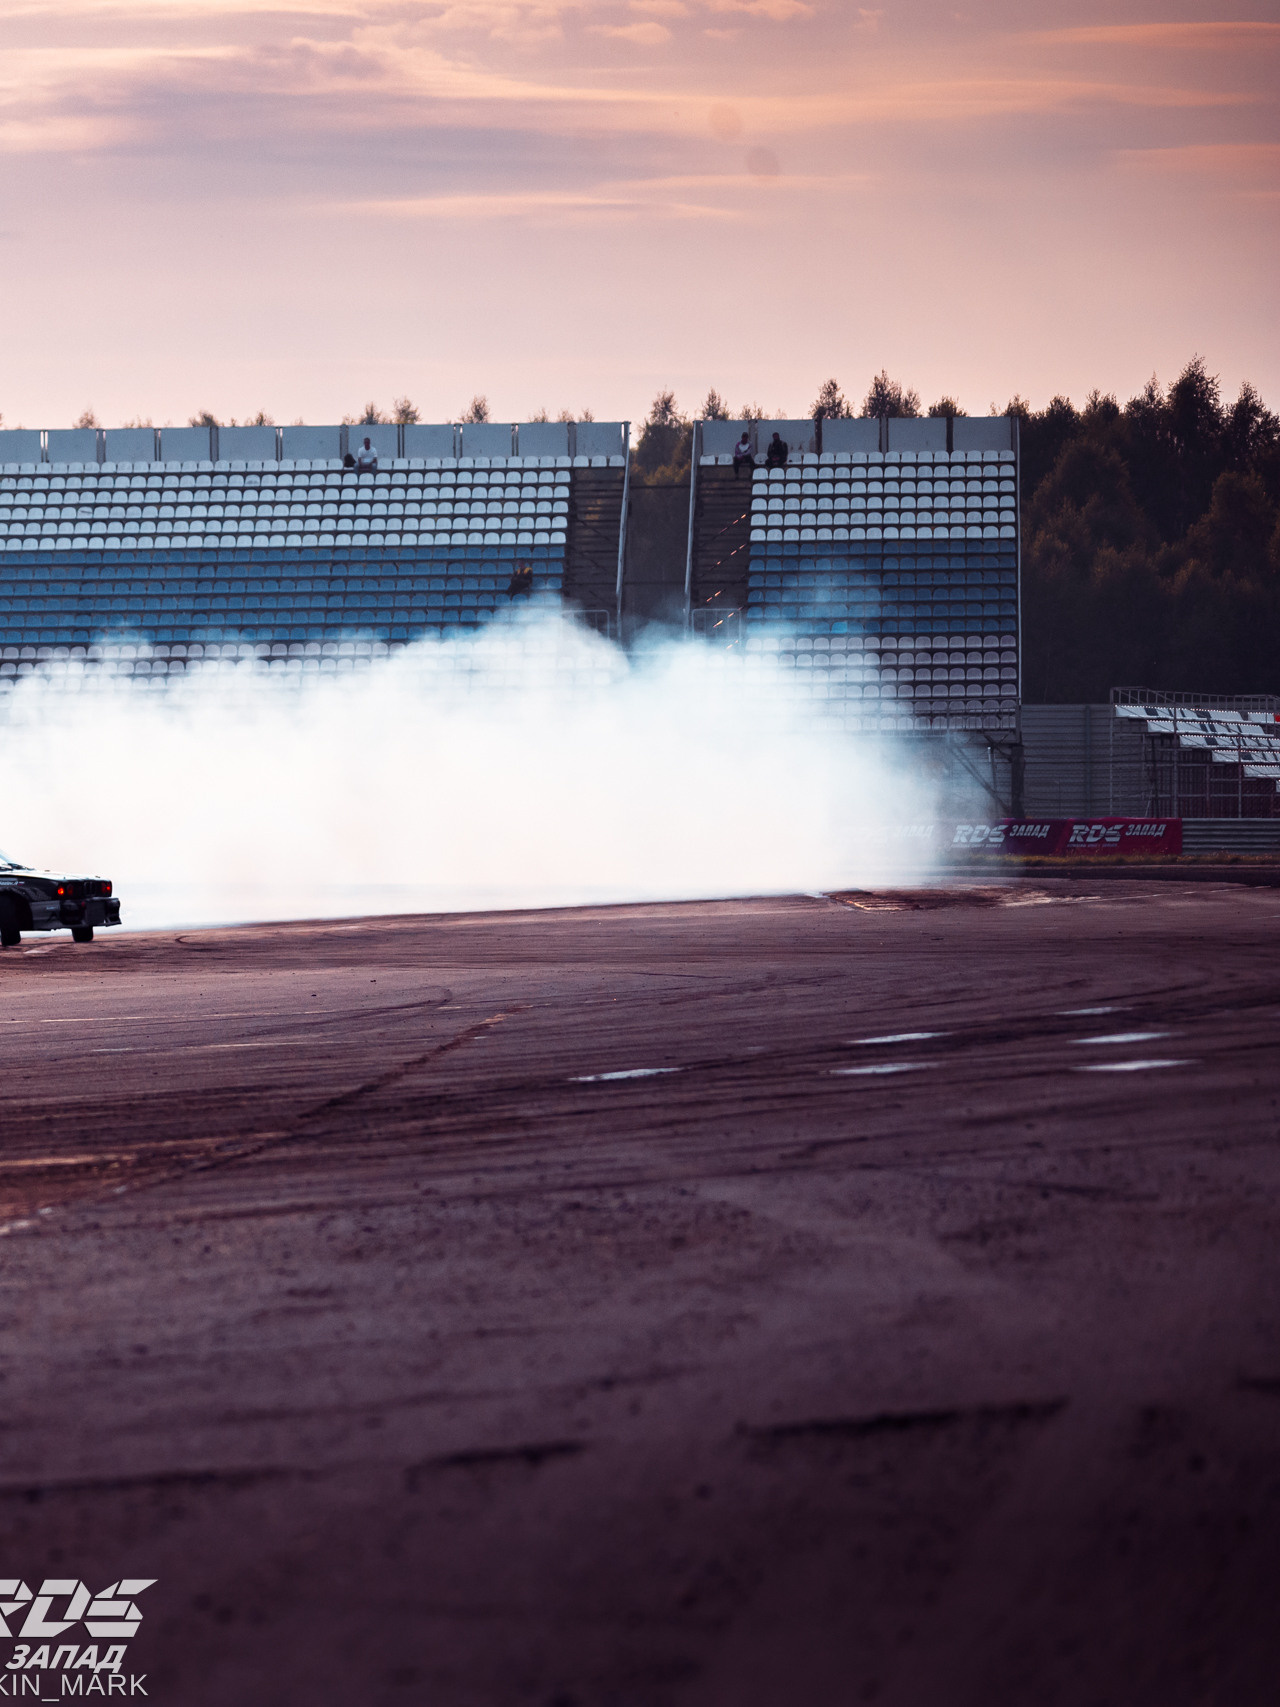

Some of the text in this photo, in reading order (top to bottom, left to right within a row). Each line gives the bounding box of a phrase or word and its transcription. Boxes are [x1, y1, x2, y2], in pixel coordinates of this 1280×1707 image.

[952, 824, 1009, 843] RDS
[1009, 824, 1050, 838] ЗАПАД
[1069, 824, 1125, 843] RDS
[1125, 823, 1167, 838] ЗАПАД
